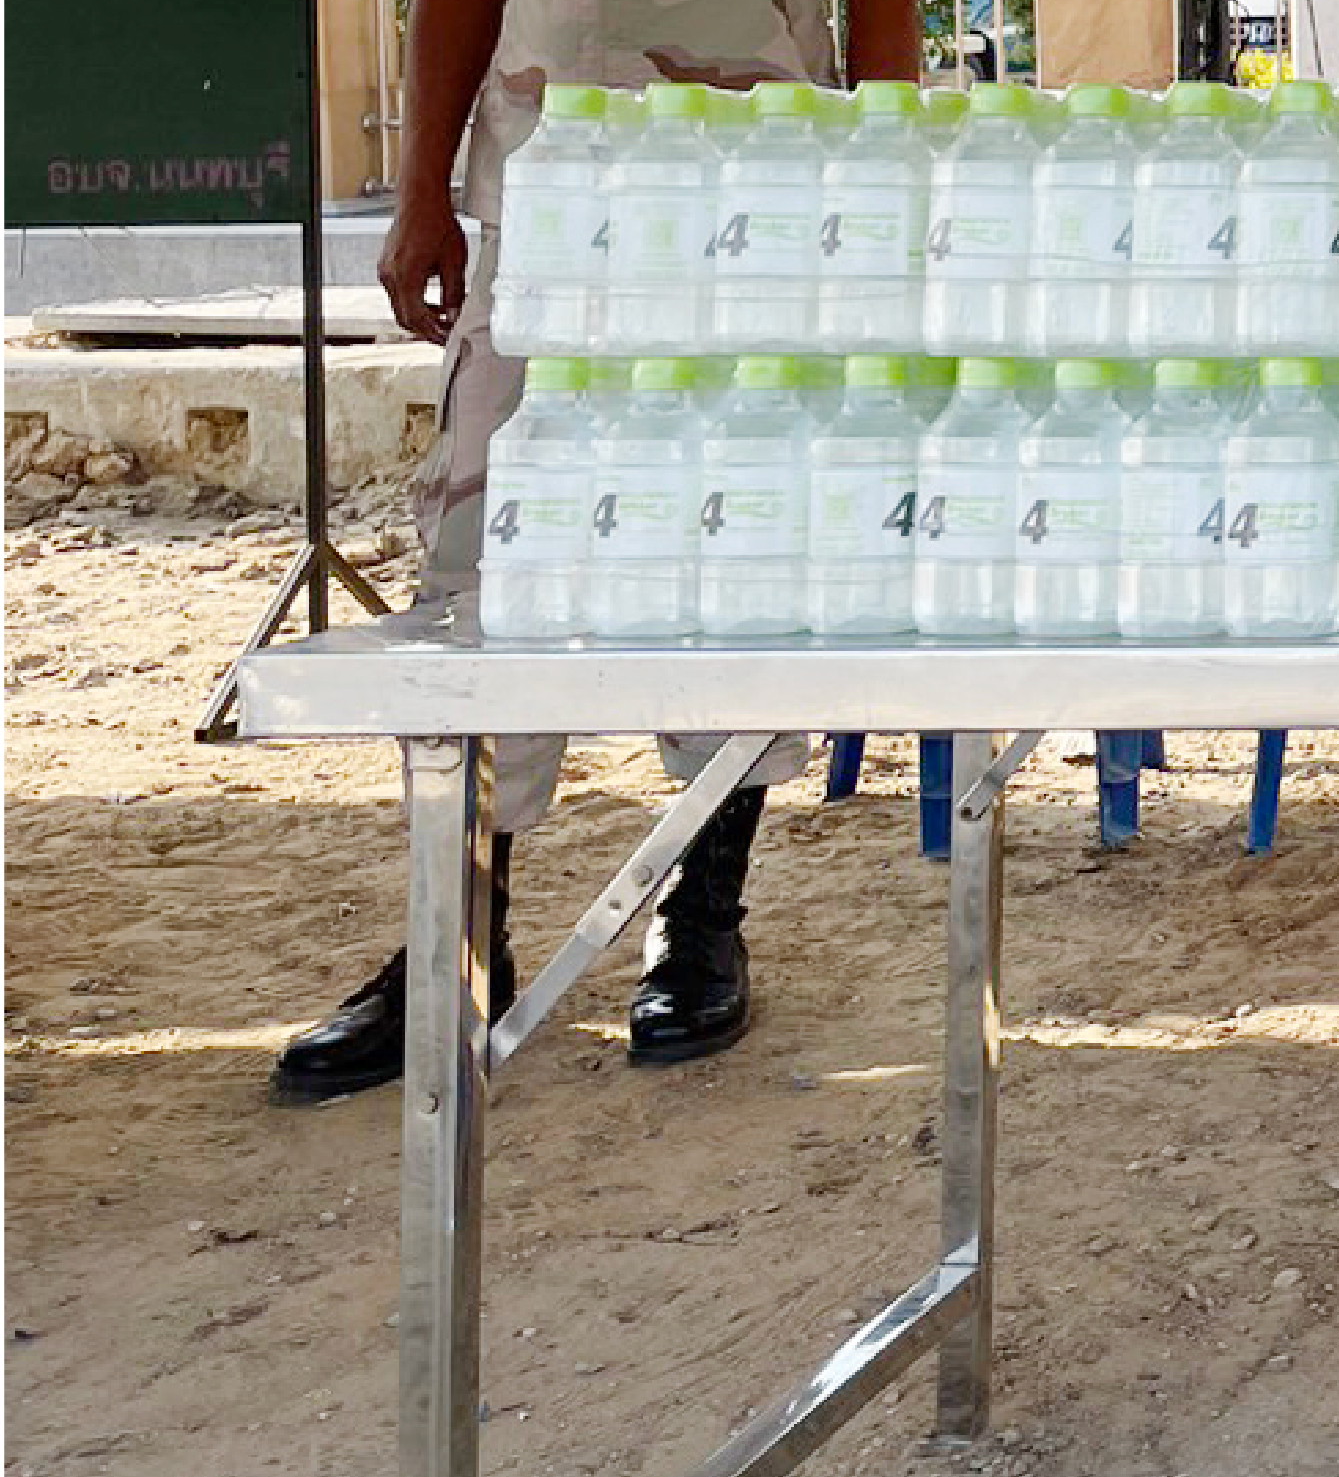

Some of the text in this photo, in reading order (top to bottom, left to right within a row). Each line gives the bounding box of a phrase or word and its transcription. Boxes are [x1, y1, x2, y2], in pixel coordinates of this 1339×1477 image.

[717, 214, 749, 256] 4
[821, 213, 841, 256] 4
[929, 218, 951, 261] 4
[1207, 216, 1236, 259] 4
[488, 500, 519, 543] 4
[594, 494, 618, 537] 4
[701, 492, 724, 536] 4
[882, 492, 916, 536] 4
[919, 496, 946, 541] 4
[1019, 500, 1048, 544] 4
[1227, 503, 1258, 548] 4
